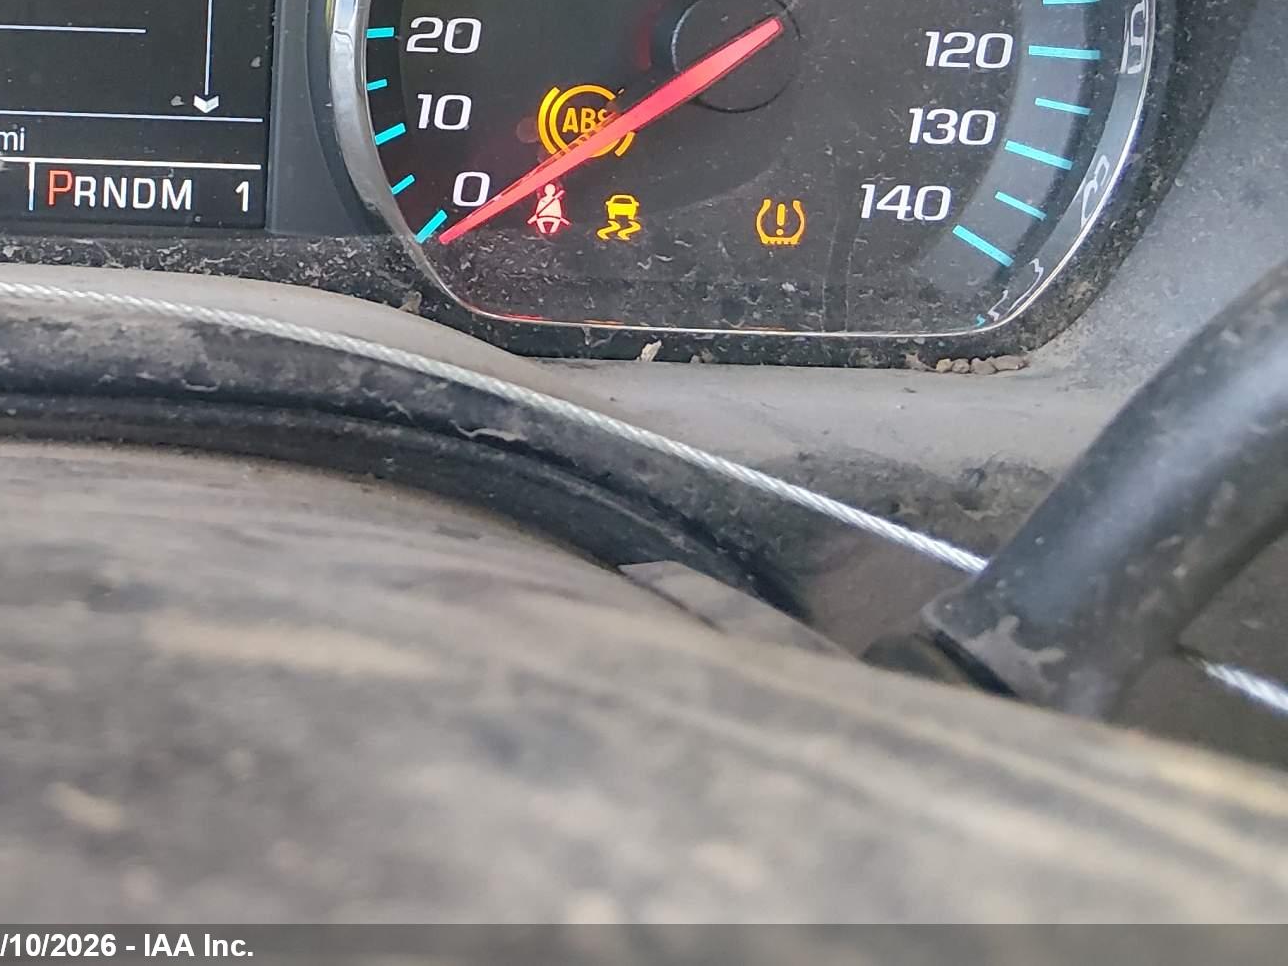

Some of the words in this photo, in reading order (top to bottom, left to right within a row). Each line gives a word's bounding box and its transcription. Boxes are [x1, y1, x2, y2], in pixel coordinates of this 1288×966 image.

[406, 18, 481, 54] 20
[925, 32, 1012, 68] 120
[417, 93, 471, 129] 10
[908, 109, 996, 145] 130
[235, 181, 249, 211] 1
[453, 173, 490, 208] 0
[860, 186, 950, 221] 140
